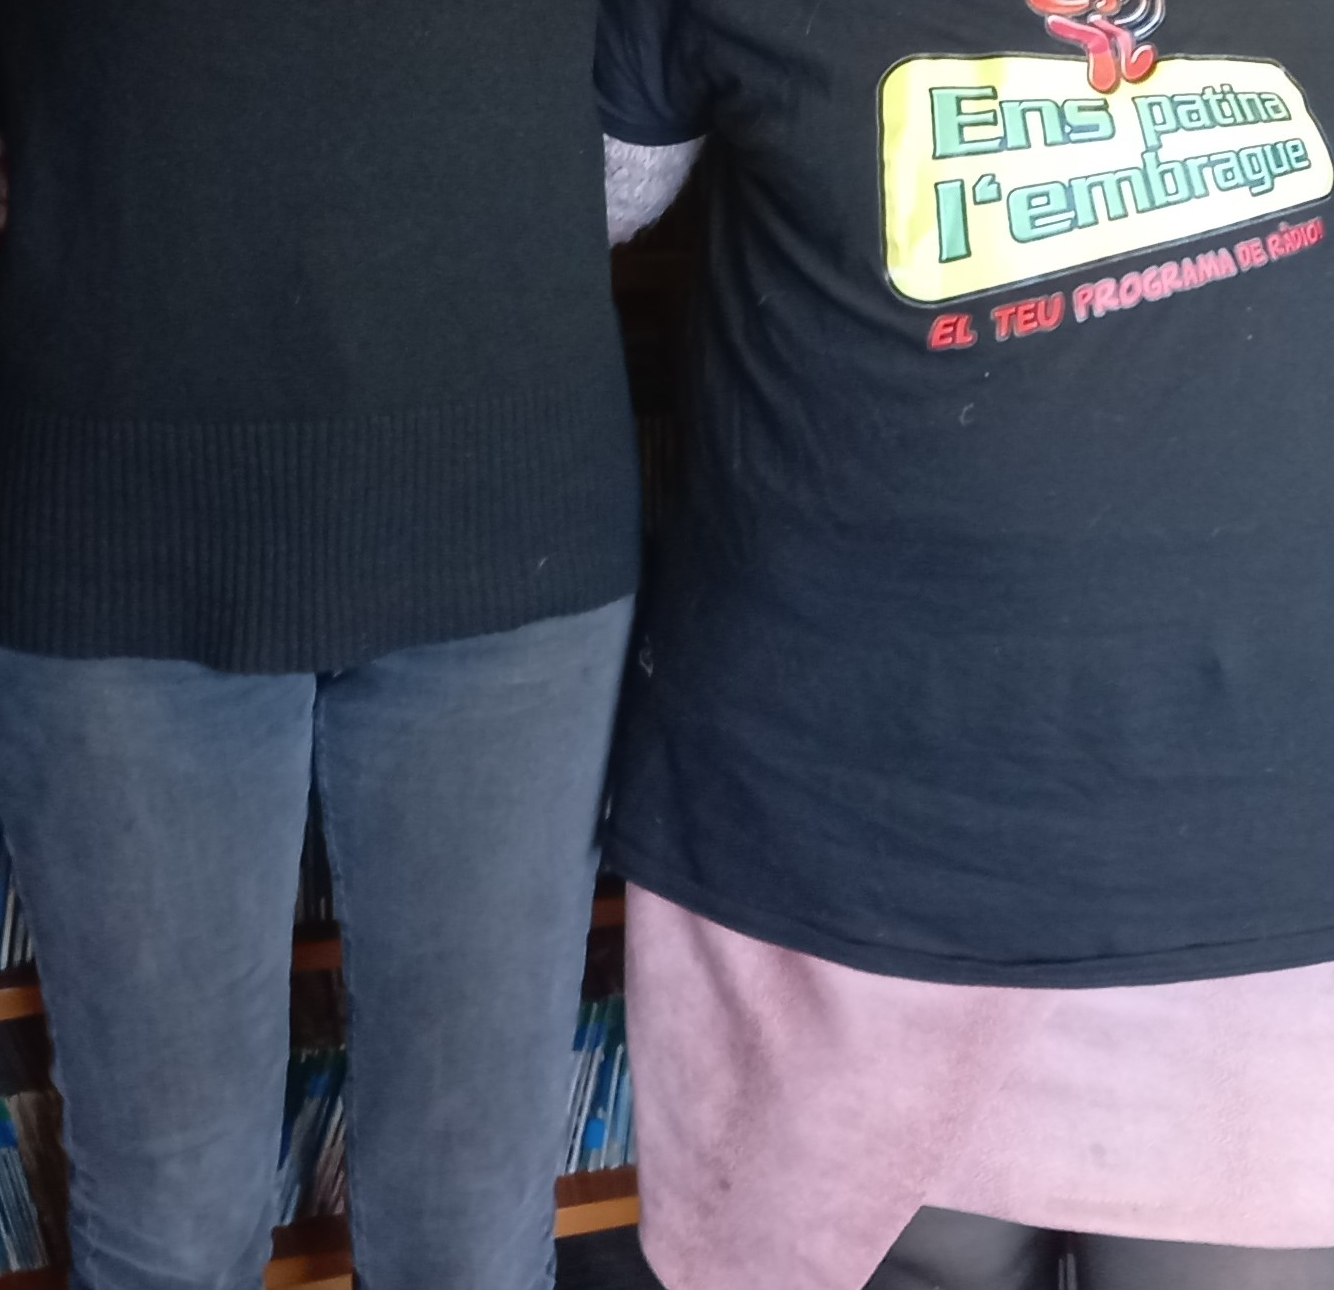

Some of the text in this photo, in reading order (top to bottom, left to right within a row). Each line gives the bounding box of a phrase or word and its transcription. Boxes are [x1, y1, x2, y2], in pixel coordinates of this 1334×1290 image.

[928, 83, 1291, 161] Ens patina
[927, 312, 978, 352] EL
[990, 293, 1065, 342] TEU
[1072, 245, 1238, 324] PROGRAMA
[1236, 237, 1269, 273] DE
